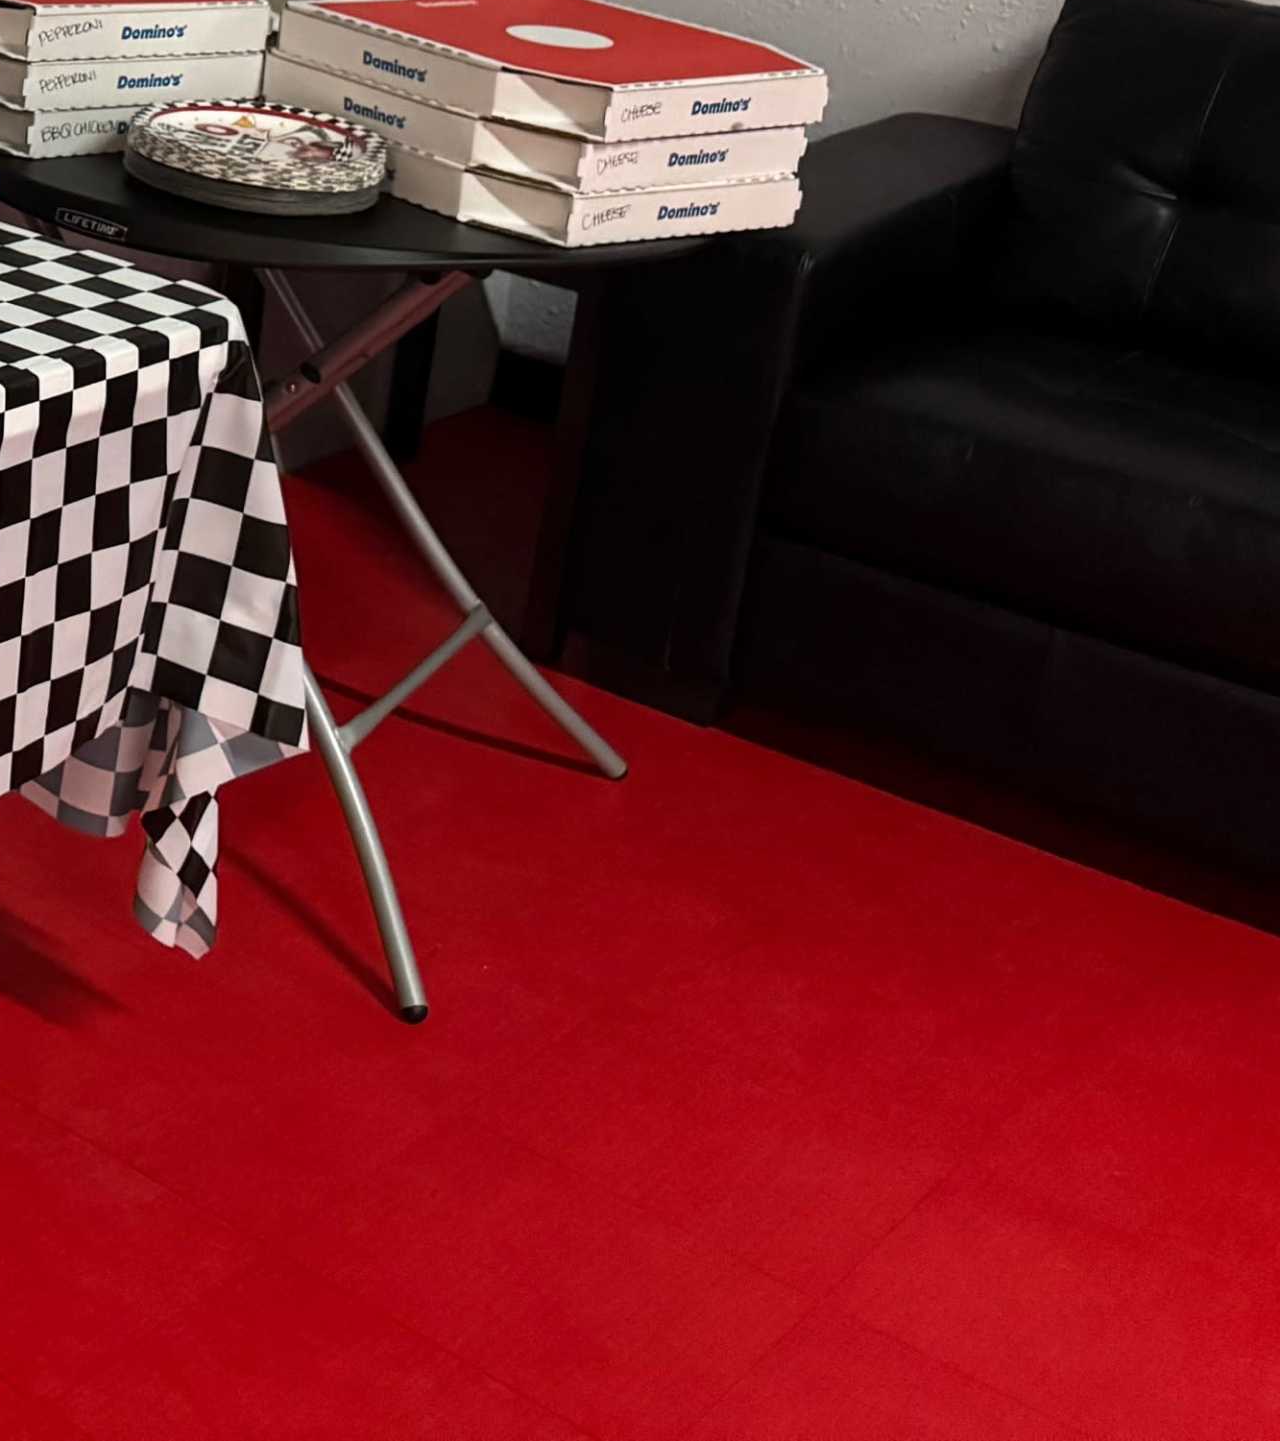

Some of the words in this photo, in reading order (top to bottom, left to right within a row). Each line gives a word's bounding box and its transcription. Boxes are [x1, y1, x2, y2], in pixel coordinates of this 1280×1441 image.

[38, 20, 104, 47] PEPPERONI
[121, 24, 188, 41] Domino's
[362, 50, 427, 83] Domino's
[117, 73, 184, 90] Domino's
[343, 96, 406, 129] Domino's
[621, 101, 663, 123] CHEESE
[691, 97, 752, 116] Domino's
[668, 148, 730, 168] Domino's
[581, 204, 632, 231] CHEESE
[657, 202, 720, 221] Domino's
